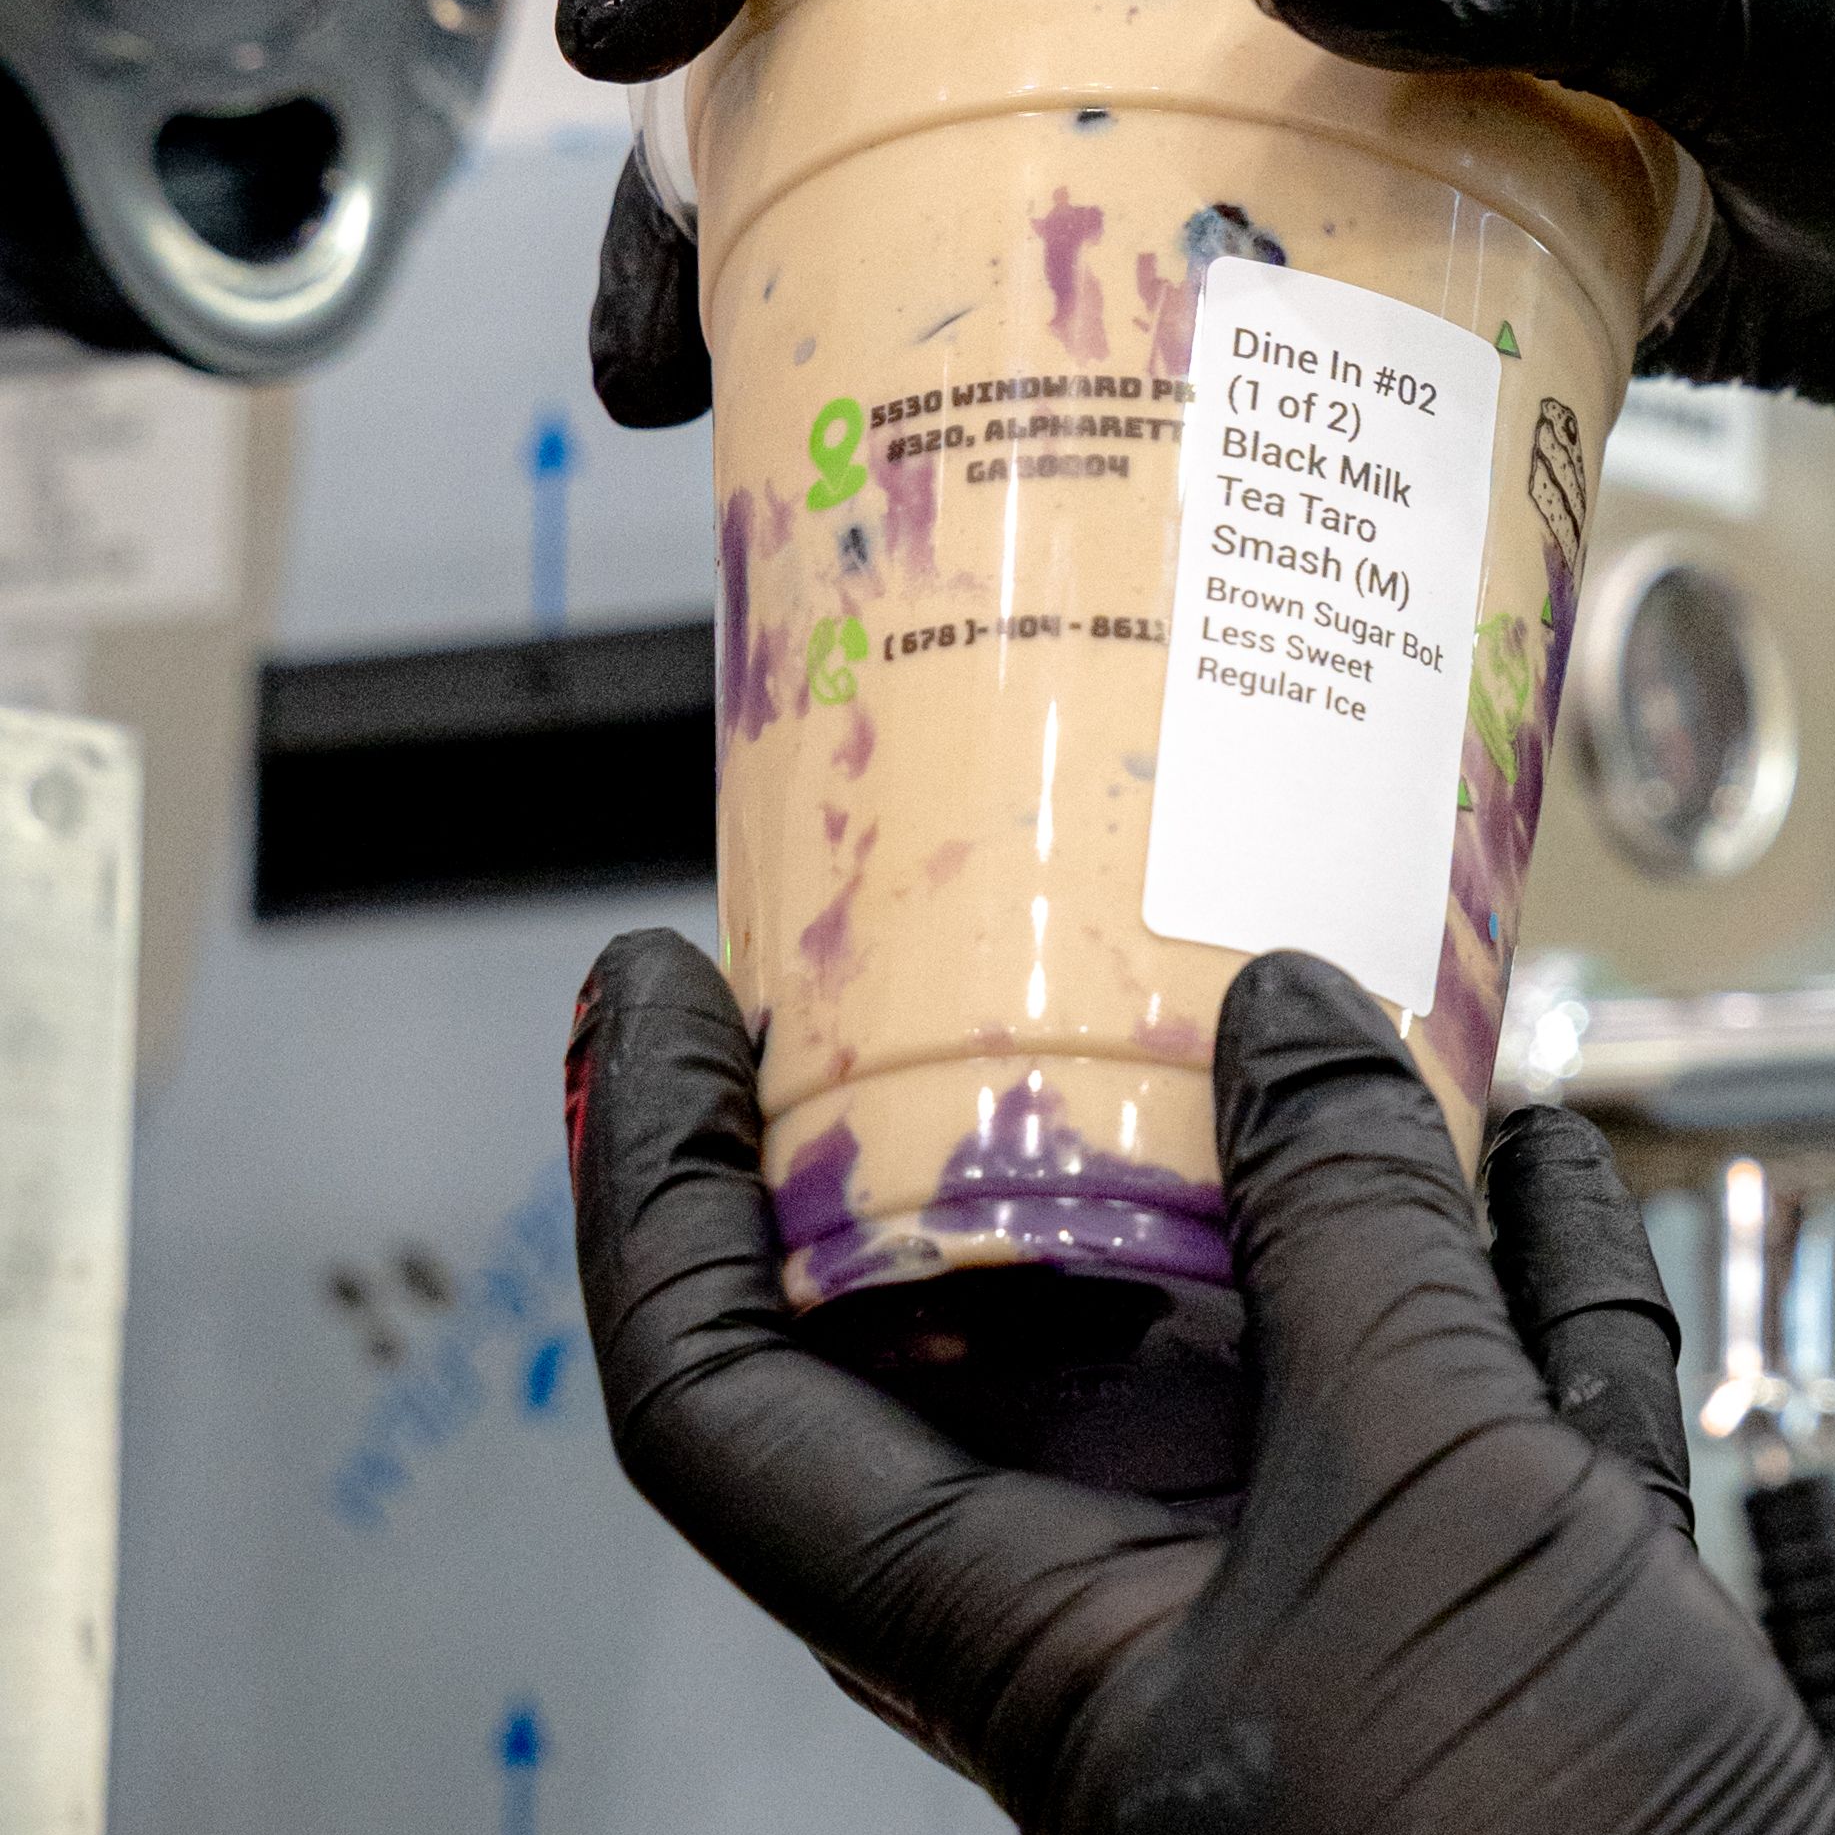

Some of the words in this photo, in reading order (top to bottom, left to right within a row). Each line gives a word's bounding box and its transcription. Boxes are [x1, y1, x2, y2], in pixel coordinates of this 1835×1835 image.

[870, 389, 943, 430] 5530
[951, 375, 1142, 407] WINDWARD
[1232, 326, 1319, 375] Dine
[1329, 350, 1362, 388] In
[1373, 365, 1438, 417] #02
[1227, 374, 1260, 415] (1
[1278, 392, 1319, 424] of
[1327, 400, 1362, 443] 2)
[887, 424, 976, 463] #320,
[965, 457, 1008, 483] GA
[1222, 426, 1328, 480] Black
[1339, 454, 1412, 508] Milk
[1216, 474, 1286, 518] Tea
[1299, 492, 1377, 543] Taro
[1211, 524, 1343, 583] Smash
[1355, 557, 1411, 612] (M)
[1206, 576, 1305, 619] Brown
[1313, 601, 1396, 648] Sugar
[1202, 616, 1276, 654] Less
[1286, 634, 1375, 683] Sweet
[1197, 656, 1317, 705] Regular
[1325, 685, 1368, 722] Ice
